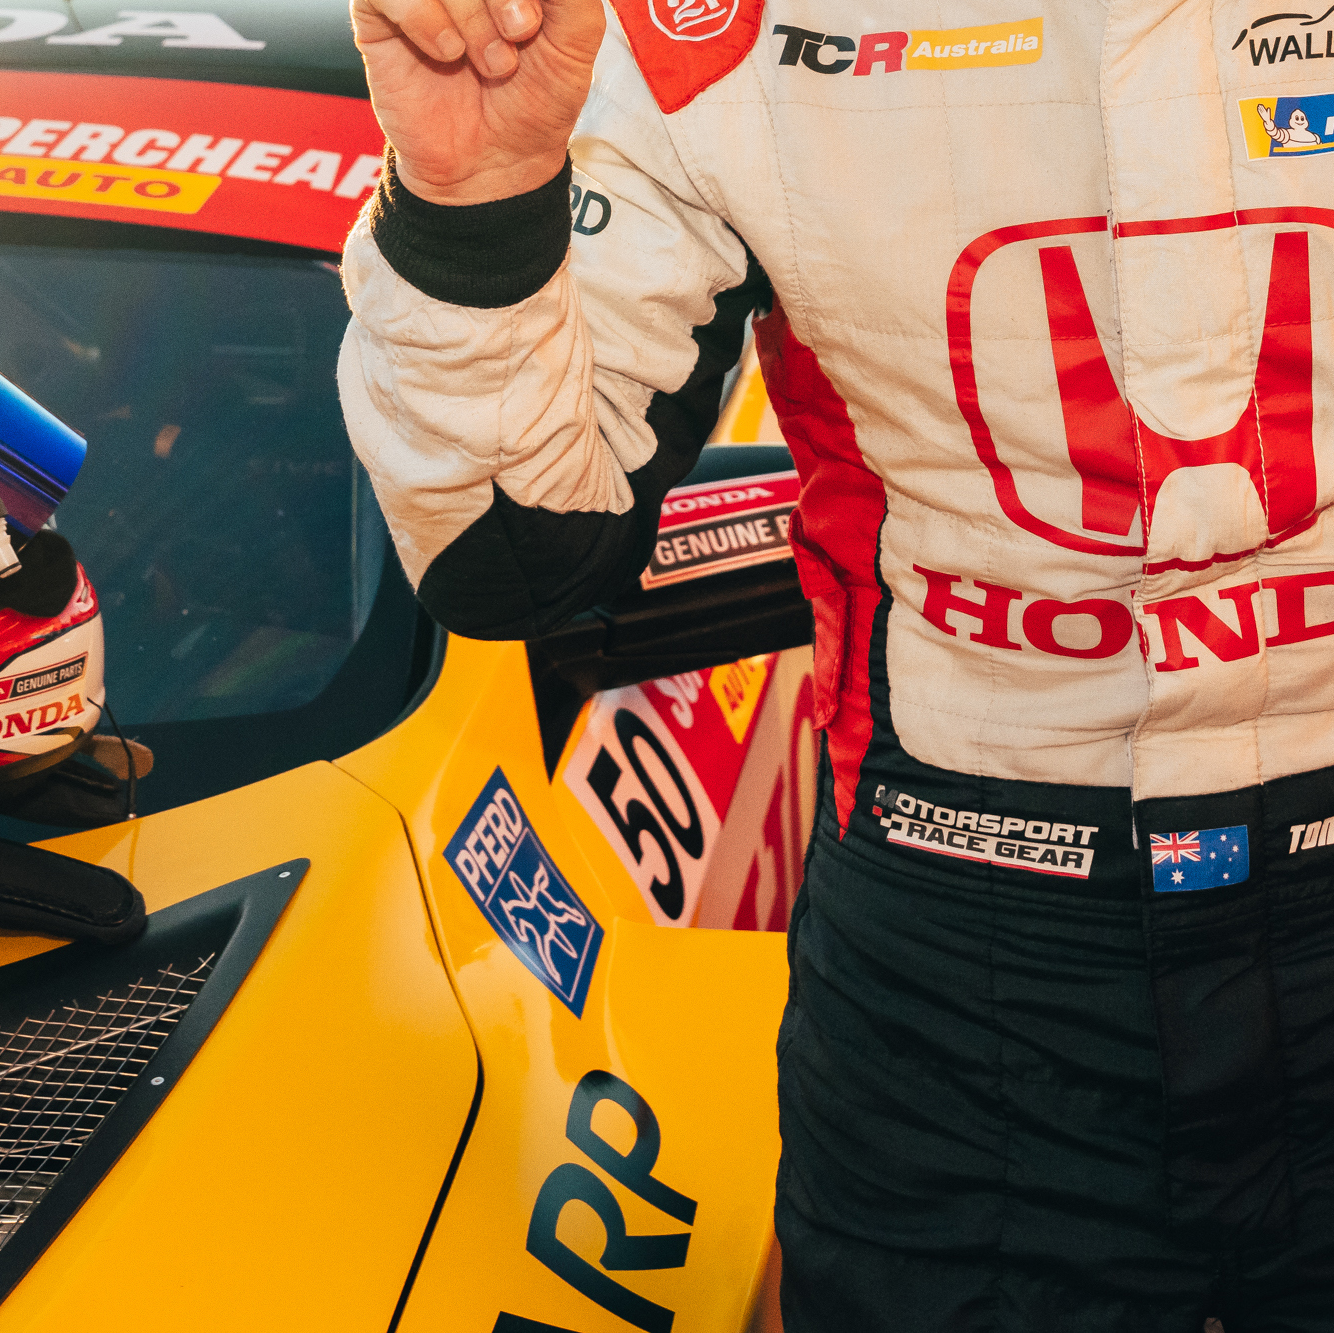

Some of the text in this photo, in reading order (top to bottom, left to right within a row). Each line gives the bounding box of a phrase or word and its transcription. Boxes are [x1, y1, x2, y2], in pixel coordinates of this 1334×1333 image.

[772, 24, 1038, 76] TCR Australia
[655, 518, 776, 566] GENUINE
[17, 669, 58, 694] GENUINE
[59, 662, 84, 681] PARTS
[586, 708, 705, 921] 50
[874, 784, 1100, 846] MOTORSPORT
[455, 787, 524, 902] PFERD
[906, 821, 1085, 869] RACE GEAR
